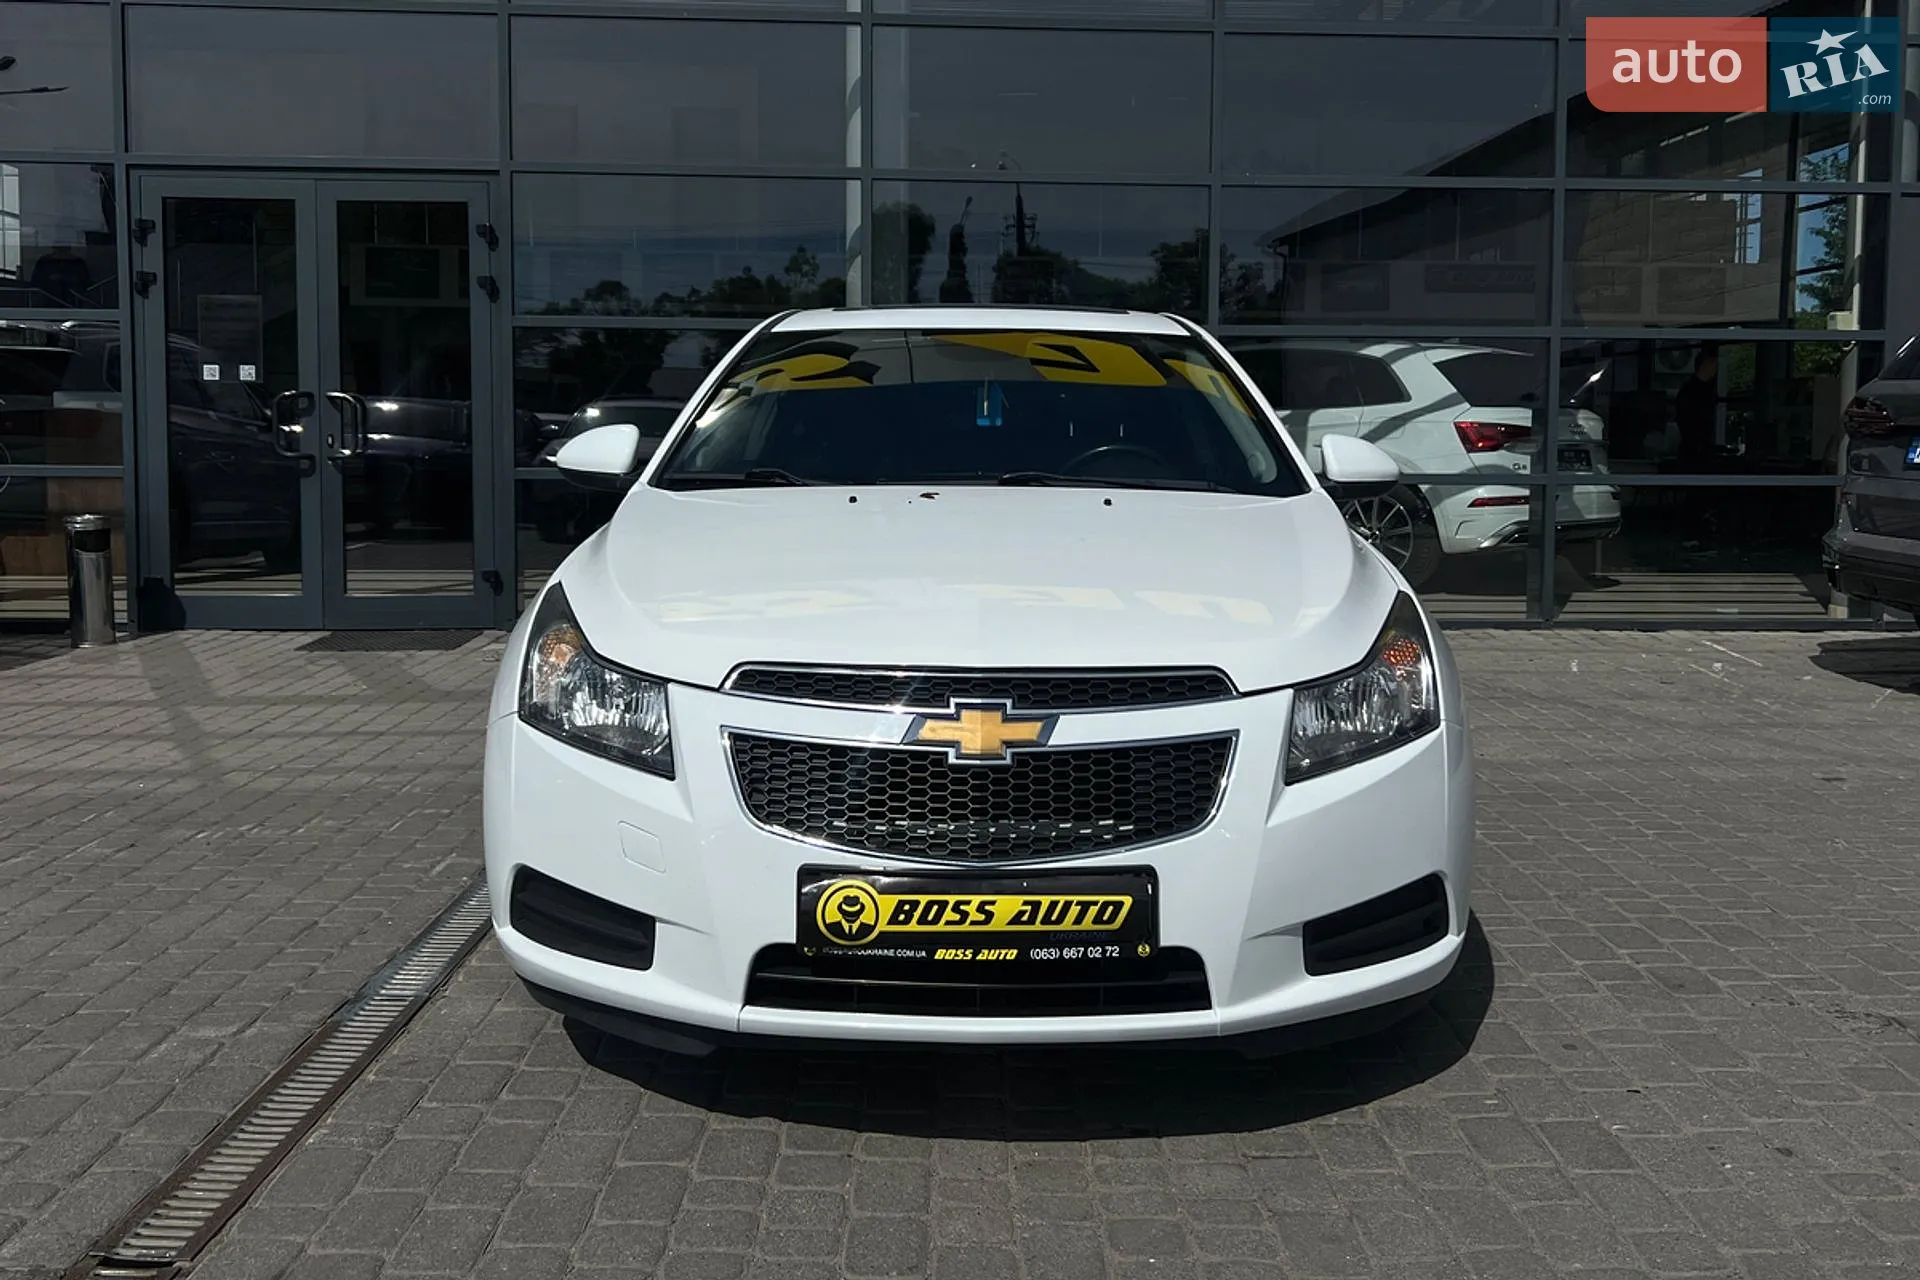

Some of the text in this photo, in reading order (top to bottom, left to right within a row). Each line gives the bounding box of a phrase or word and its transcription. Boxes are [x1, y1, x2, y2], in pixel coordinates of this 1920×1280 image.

[887, 899, 1128, 926] BOSS AUTO
[822, 947, 928, 958] OUKRAINE.COM.UA
[934, 948, 1019, 960] BOSS AUTO
[1030, 945, 1120, 960] (063) 667 02 72
